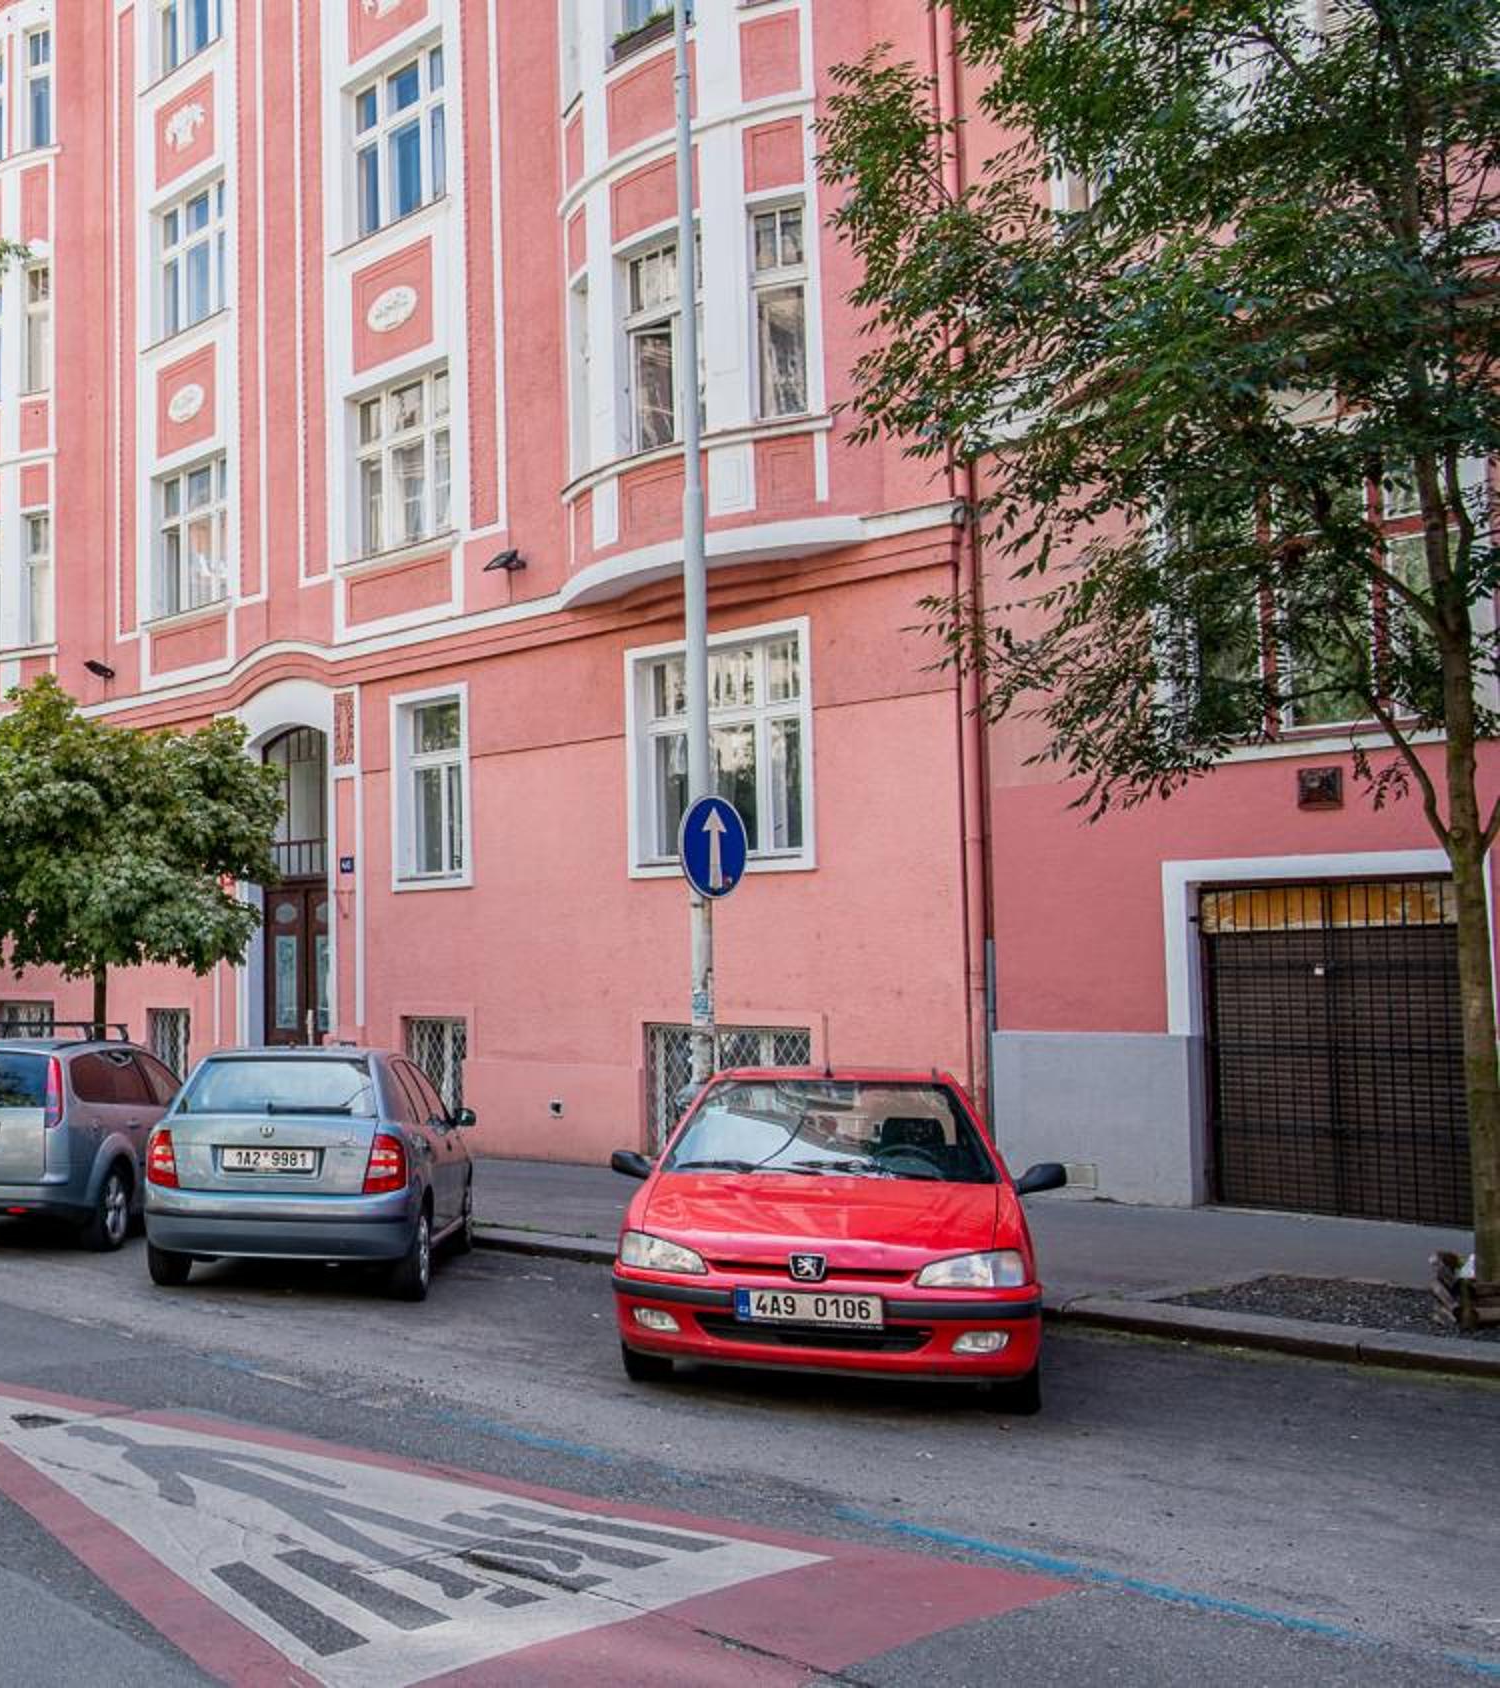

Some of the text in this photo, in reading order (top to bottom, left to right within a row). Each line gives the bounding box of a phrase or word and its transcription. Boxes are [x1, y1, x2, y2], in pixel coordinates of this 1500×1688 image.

[236, 1151, 306, 1167] 1A2 9981
[755, 1294, 796, 1316] 4A9
[814, 1297, 871, 1320] 0106
